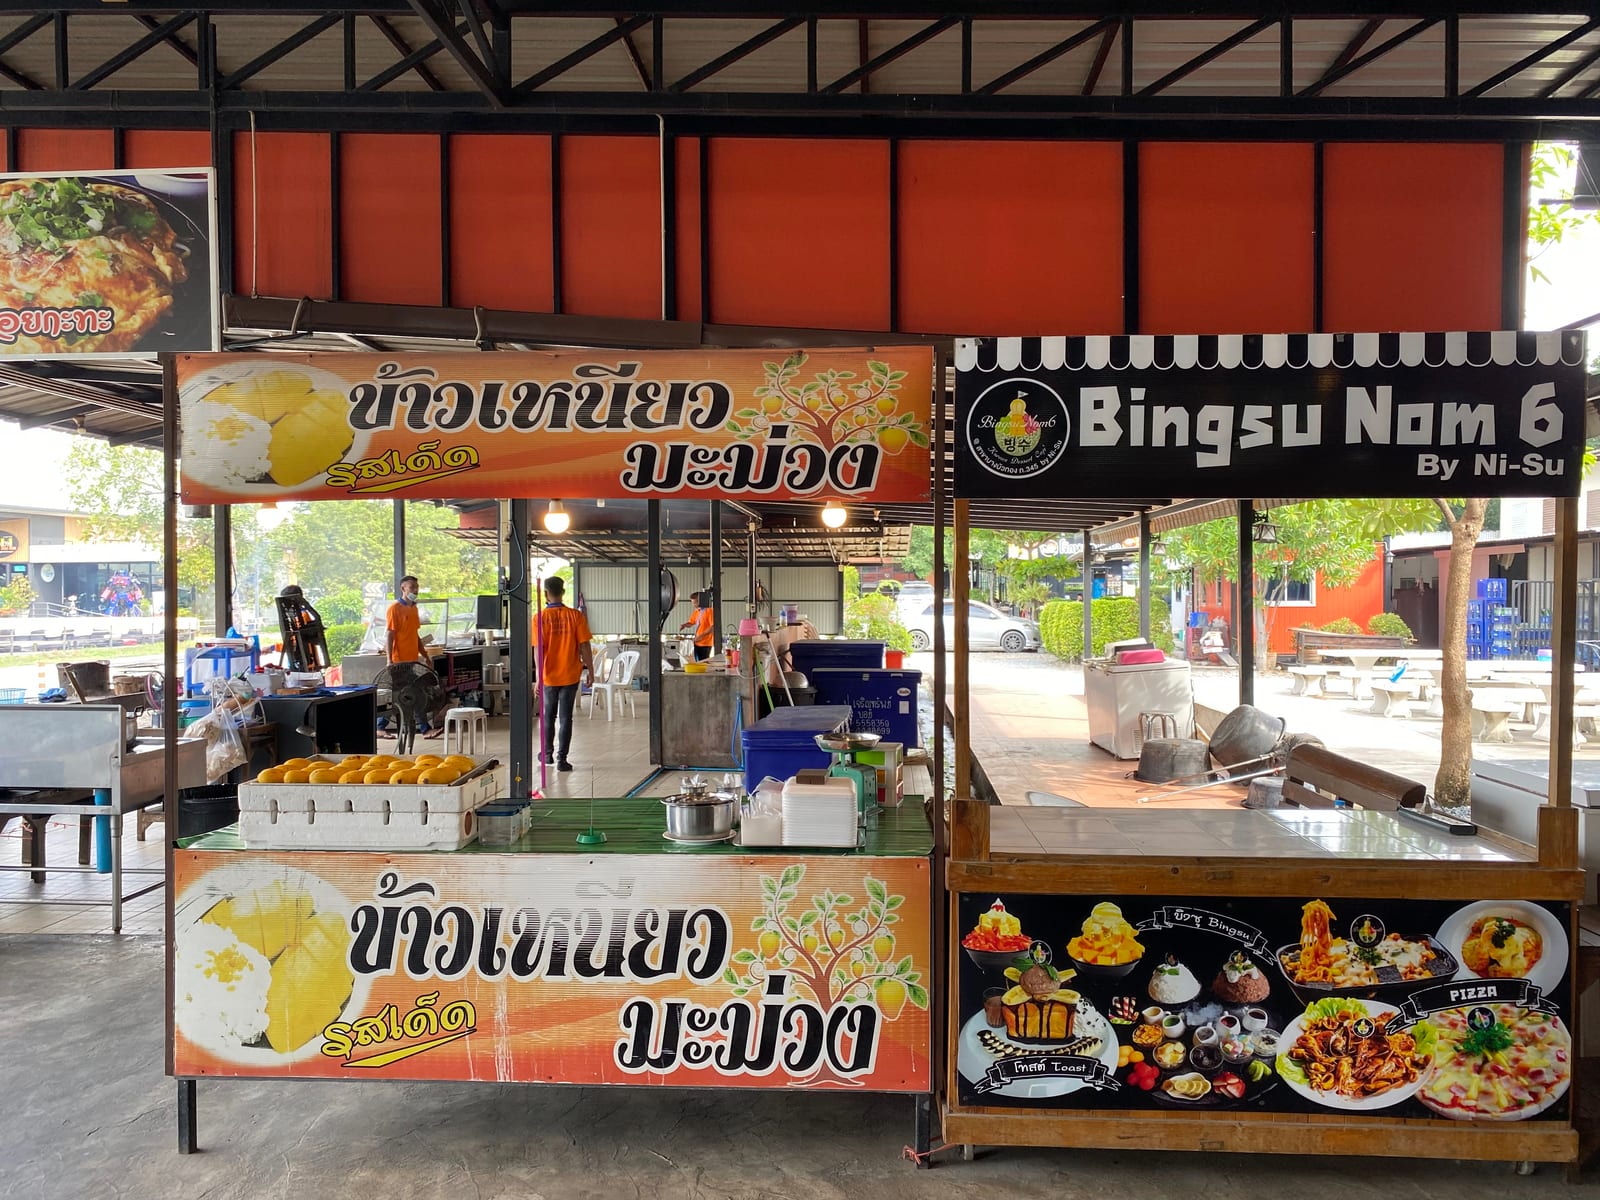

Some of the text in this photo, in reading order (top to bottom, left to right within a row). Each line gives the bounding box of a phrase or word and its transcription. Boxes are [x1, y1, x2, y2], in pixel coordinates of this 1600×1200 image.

[0, 310, 112, 341] อยกะทะ
[348, 362, 732, 431] ข้าวเหนียว
[1079, 381, 1564, 468] Bingsu Nom 6
[325, 440, 480, 488] รสเด็ด
[621, 424, 880, 491] มะม่วง
[1416, 453, 1564, 481] By Ni-Su
[348, 871, 729, 980] ข้าวเหนียว
[1208, 916, 1250, 940] Bingsu
[1449, 985, 1498, 1002] PIZZA
[321, 991, 477, 1059] รสเด็ด
[616, 974, 880, 1074] มะม่วง
[1051, 1062, 1087, 1072] Toast
